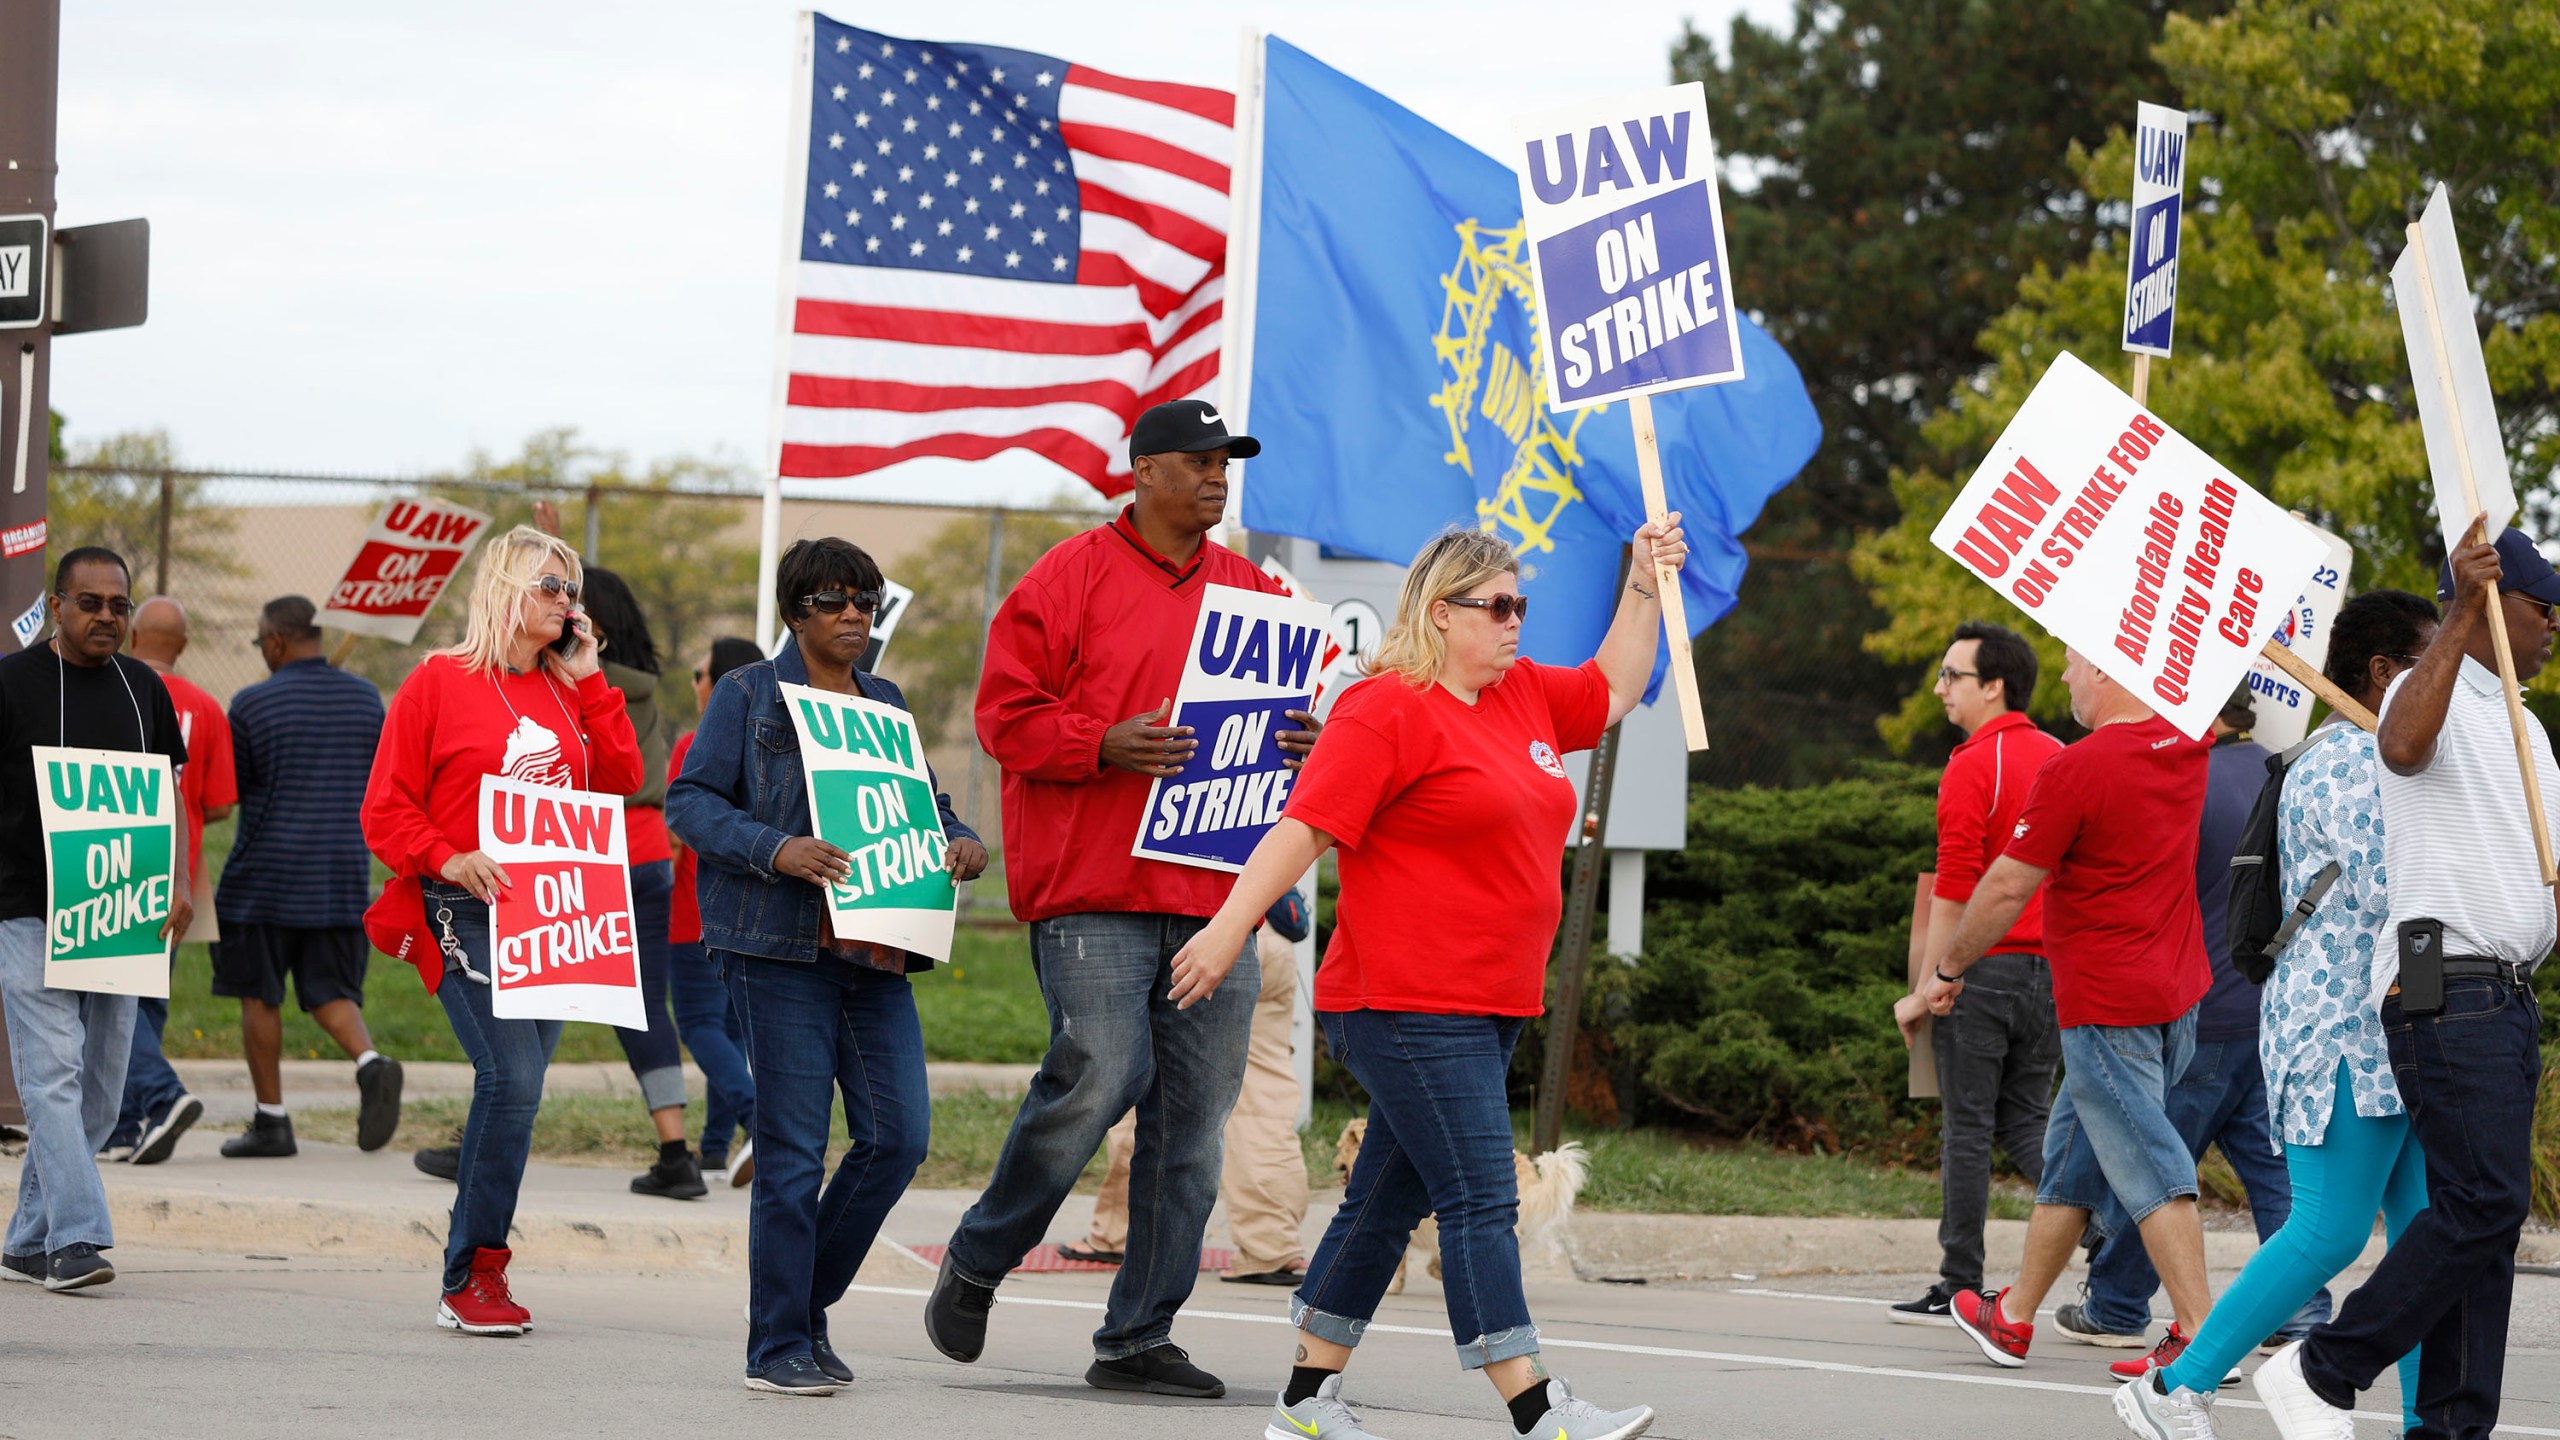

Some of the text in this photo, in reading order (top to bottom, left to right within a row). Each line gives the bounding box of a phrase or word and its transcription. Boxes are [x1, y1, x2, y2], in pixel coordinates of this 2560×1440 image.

[1526, 111, 1690, 204] UAW
[2140, 126, 2183, 188] UAW
[1596, 211, 1660, 294] ON
[2147, 208, 2166, 267] ON
[1560, 259, 1719, 389] STRIKE
[2129, 257, 2175, 335] STRIKE
[385, 502, 480, 545] UAW
[1953, 456, 2061, 578] UAW
[2012, 414, 2165, 608] ON STRIKE FOR
[334, 575, 450, 608] STRIKE
[377, 552, 430, 580] ON
[2114, 492, 2184, 666] Affordable
[2153, 585, 2211, 706] Quality
[2183, 477, 2238, 590] Health
[1346, 617, 1359, 656] 1
[2218, 567, 2263, 648] Care
[2300, 608, 2314, 639] City
[1199, 610, 1321, 690] UAW
[2253, 661, 2275, 671] ocal
[2247, 670, 2301, 708] ORTS
[797, 698, 915, 770] UAW
[1210, 709, 1271, 771] ON
[48, 761, 160, 817] UAW
[857, 779, 910, 834] ON
[1152, 769, 1293, 842] STRIKE
[493, 790, 613, 856] UAW
[86, 833, 131, 889] ON
[534, 867, 586, 917] ON
[53, 874, 169, 955] STRIKE
[397, 934, 413, 960] ARITY
[499, 911, 632, 984] STRIKE
